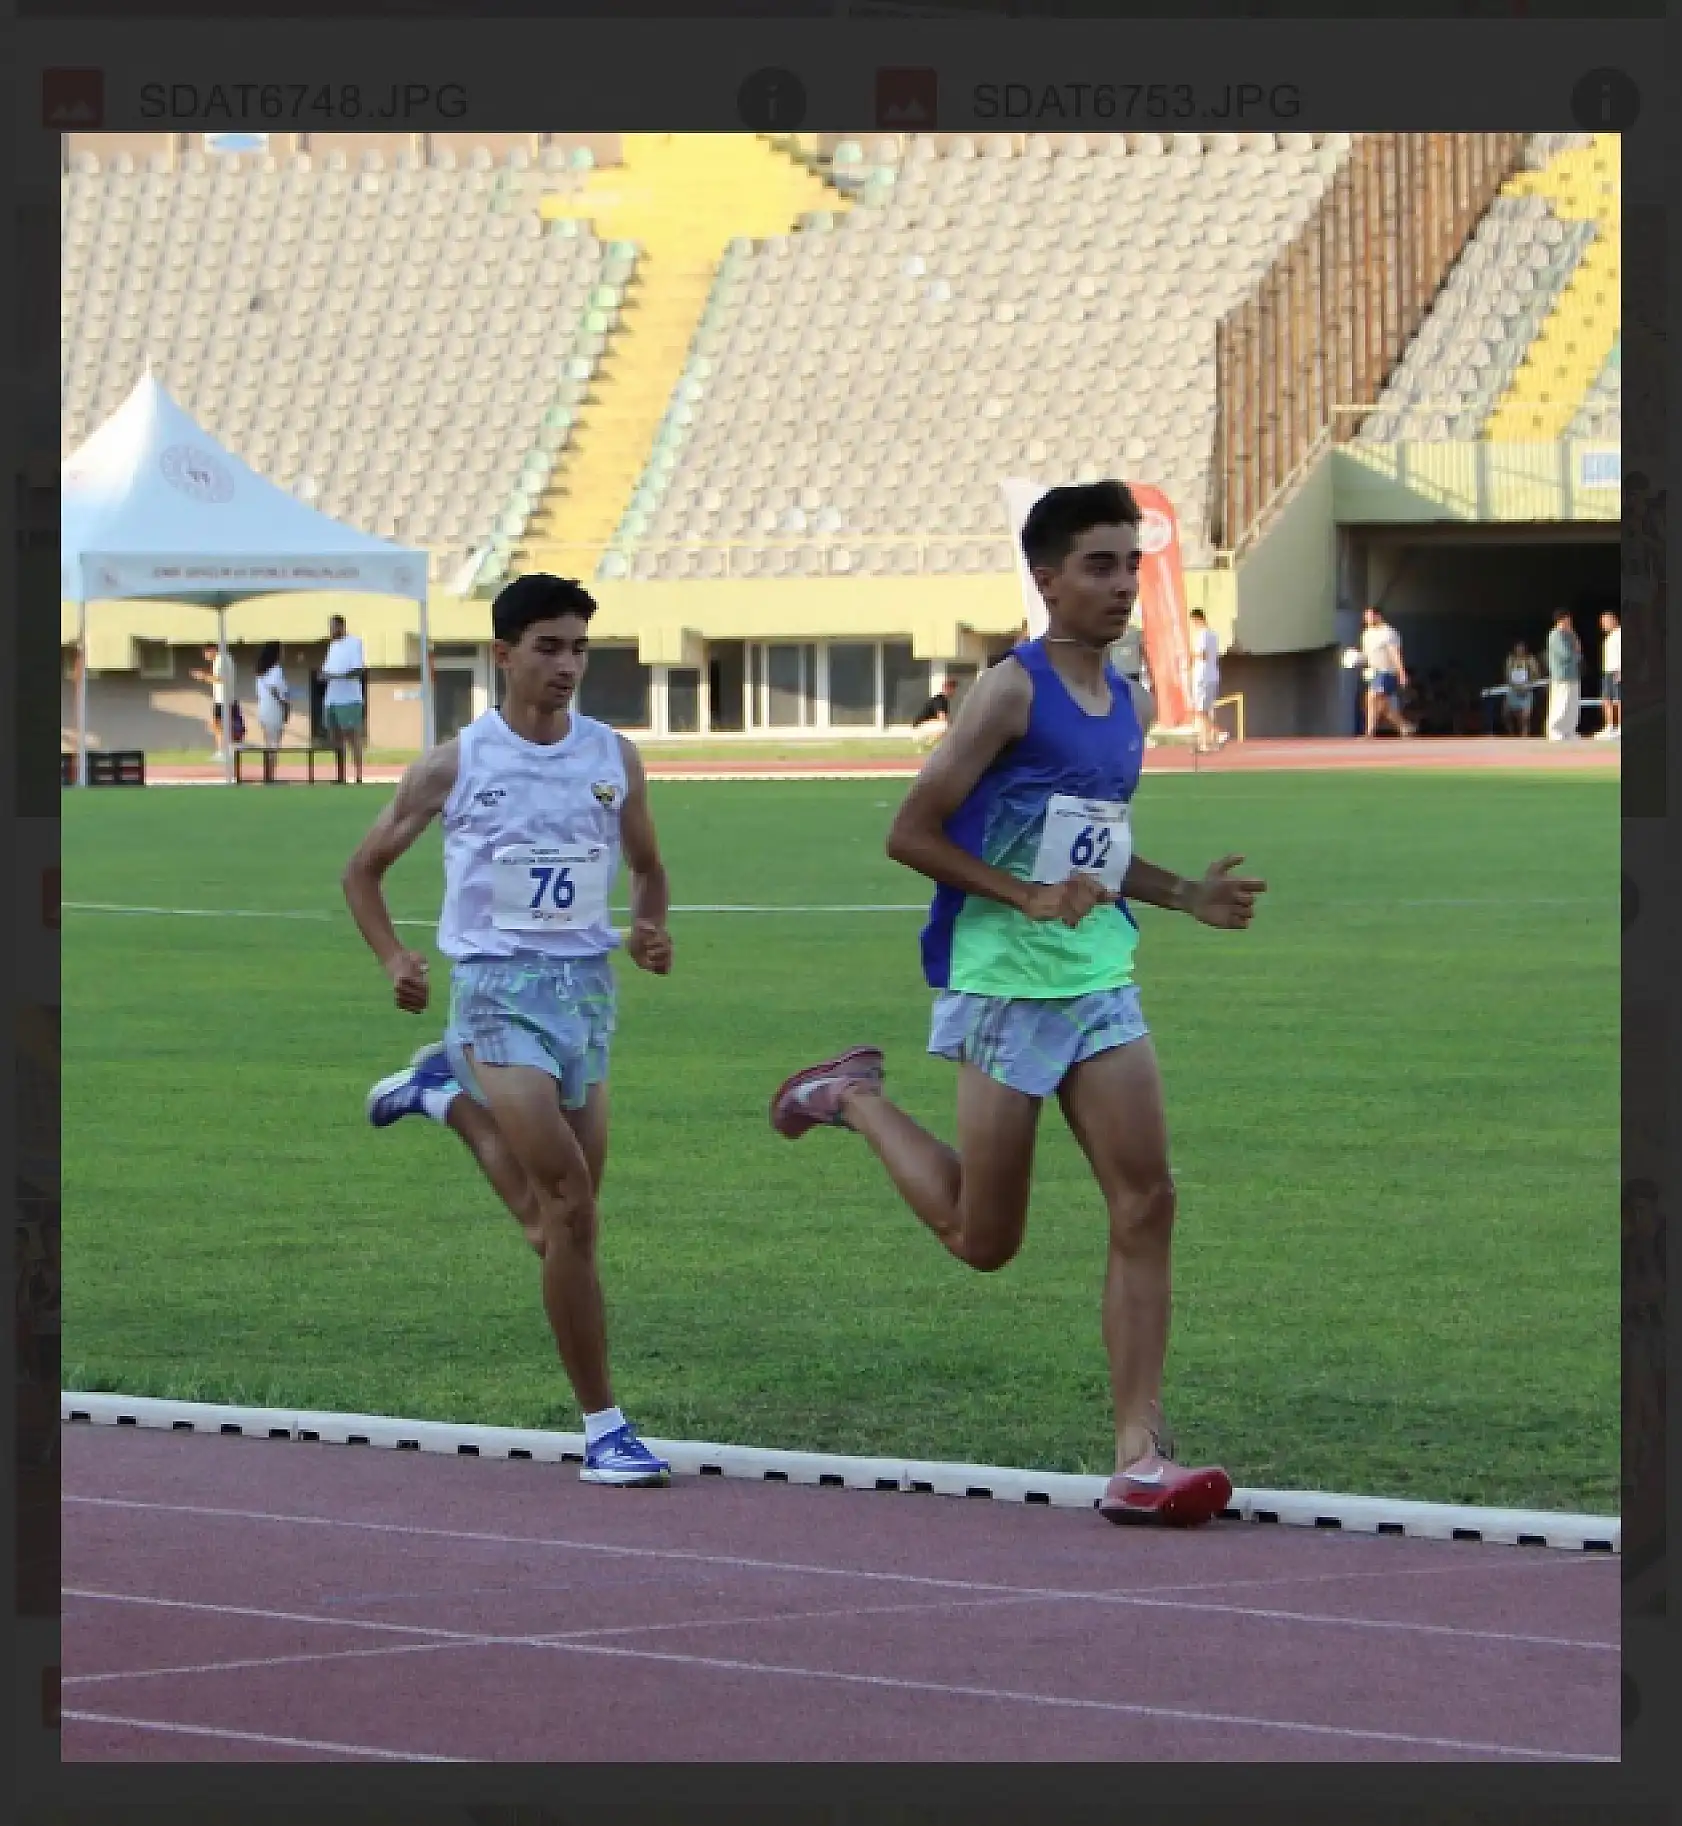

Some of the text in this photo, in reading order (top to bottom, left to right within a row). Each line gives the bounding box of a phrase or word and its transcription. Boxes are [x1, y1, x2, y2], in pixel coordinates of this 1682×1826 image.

[139, 83, 468, 119] SDAT6748.JPG
[972, 83, 1302, 119] SDAT6753.JPG
[1069, 824, 1112, 869] 62
[528, 867, 576, 910] 76
